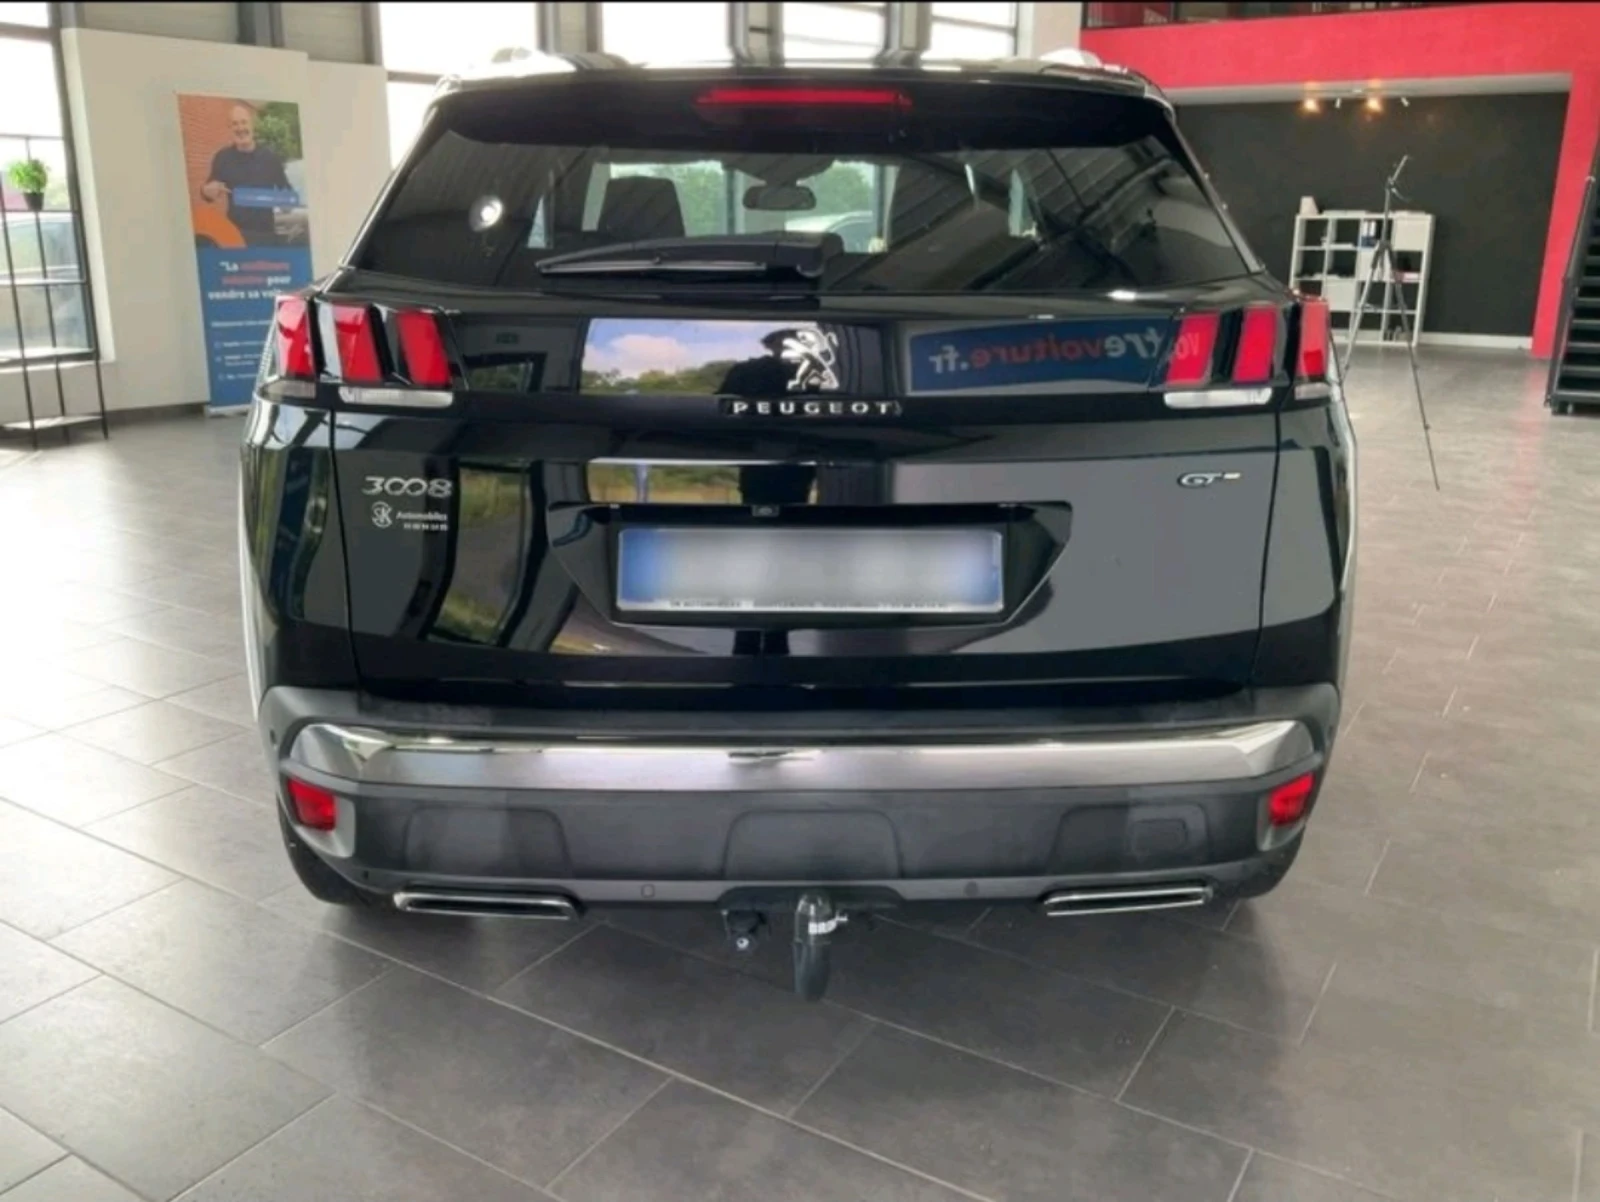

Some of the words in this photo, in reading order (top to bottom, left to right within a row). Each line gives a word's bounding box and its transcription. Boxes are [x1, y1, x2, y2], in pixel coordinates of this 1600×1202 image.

[733, 401, 889, 414] PEUGEOT
[361, 476, 452, 497] 3008
[1178, 472, 1222, 488] GT
